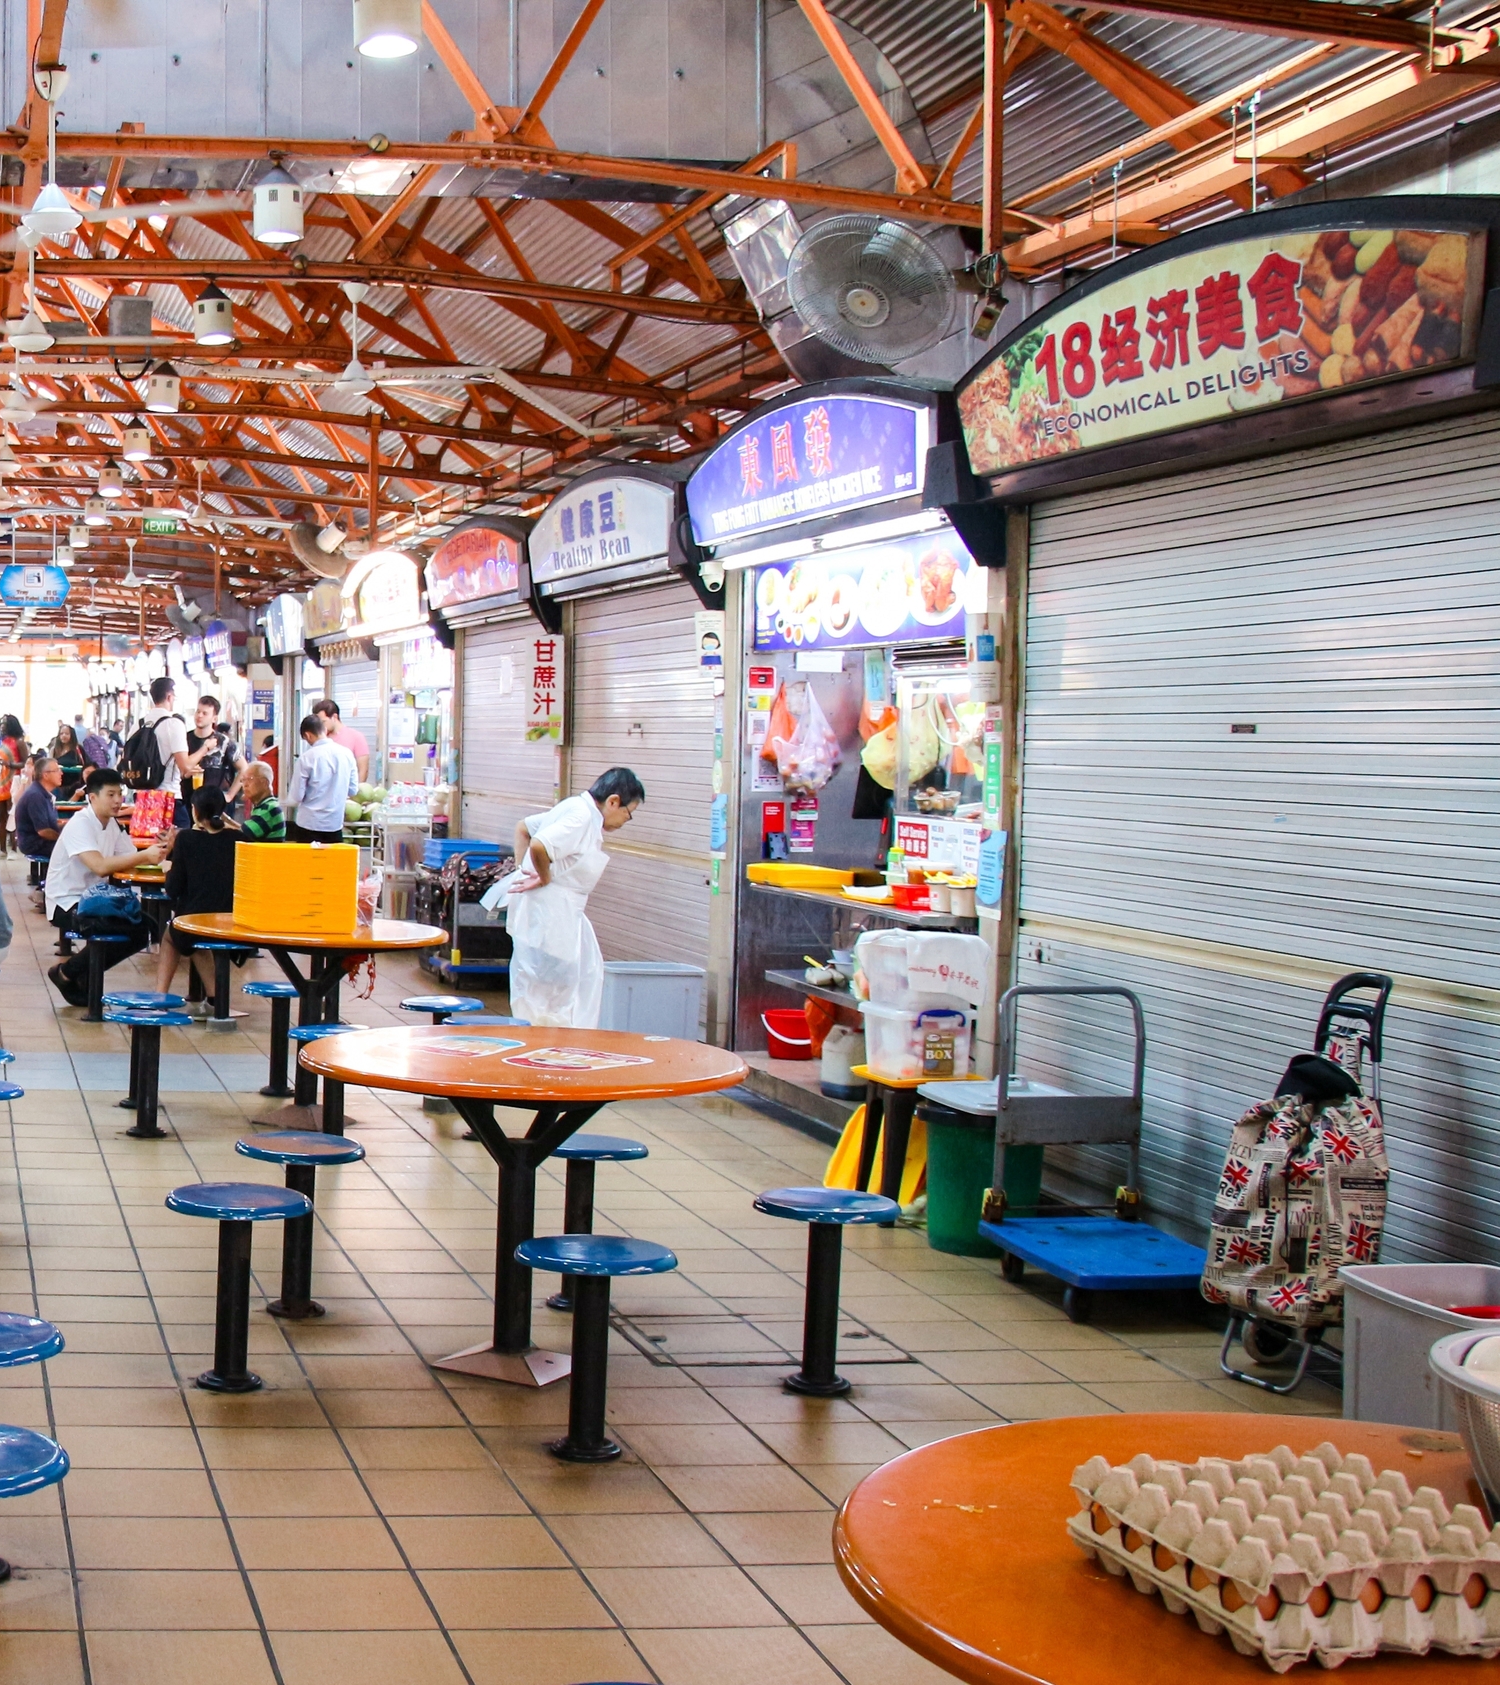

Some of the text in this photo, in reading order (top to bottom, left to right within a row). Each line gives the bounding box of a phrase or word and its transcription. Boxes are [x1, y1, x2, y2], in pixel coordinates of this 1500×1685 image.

[1042, 350, 1310, 439] ECONOMICAL DELIGHTS
[737, 405, 833, 498] 東風發
[150, 520, 171, 533] EXIT
[553, 535, 631, 571] Healthy Bean
[533, 639, 556, 716] 甘蔗汁
[925, 1049, 952, 1060] BOX
[1261, 1209, 1278, 1240] JUST
[1214, 1237, 1227, 1263] YOU
